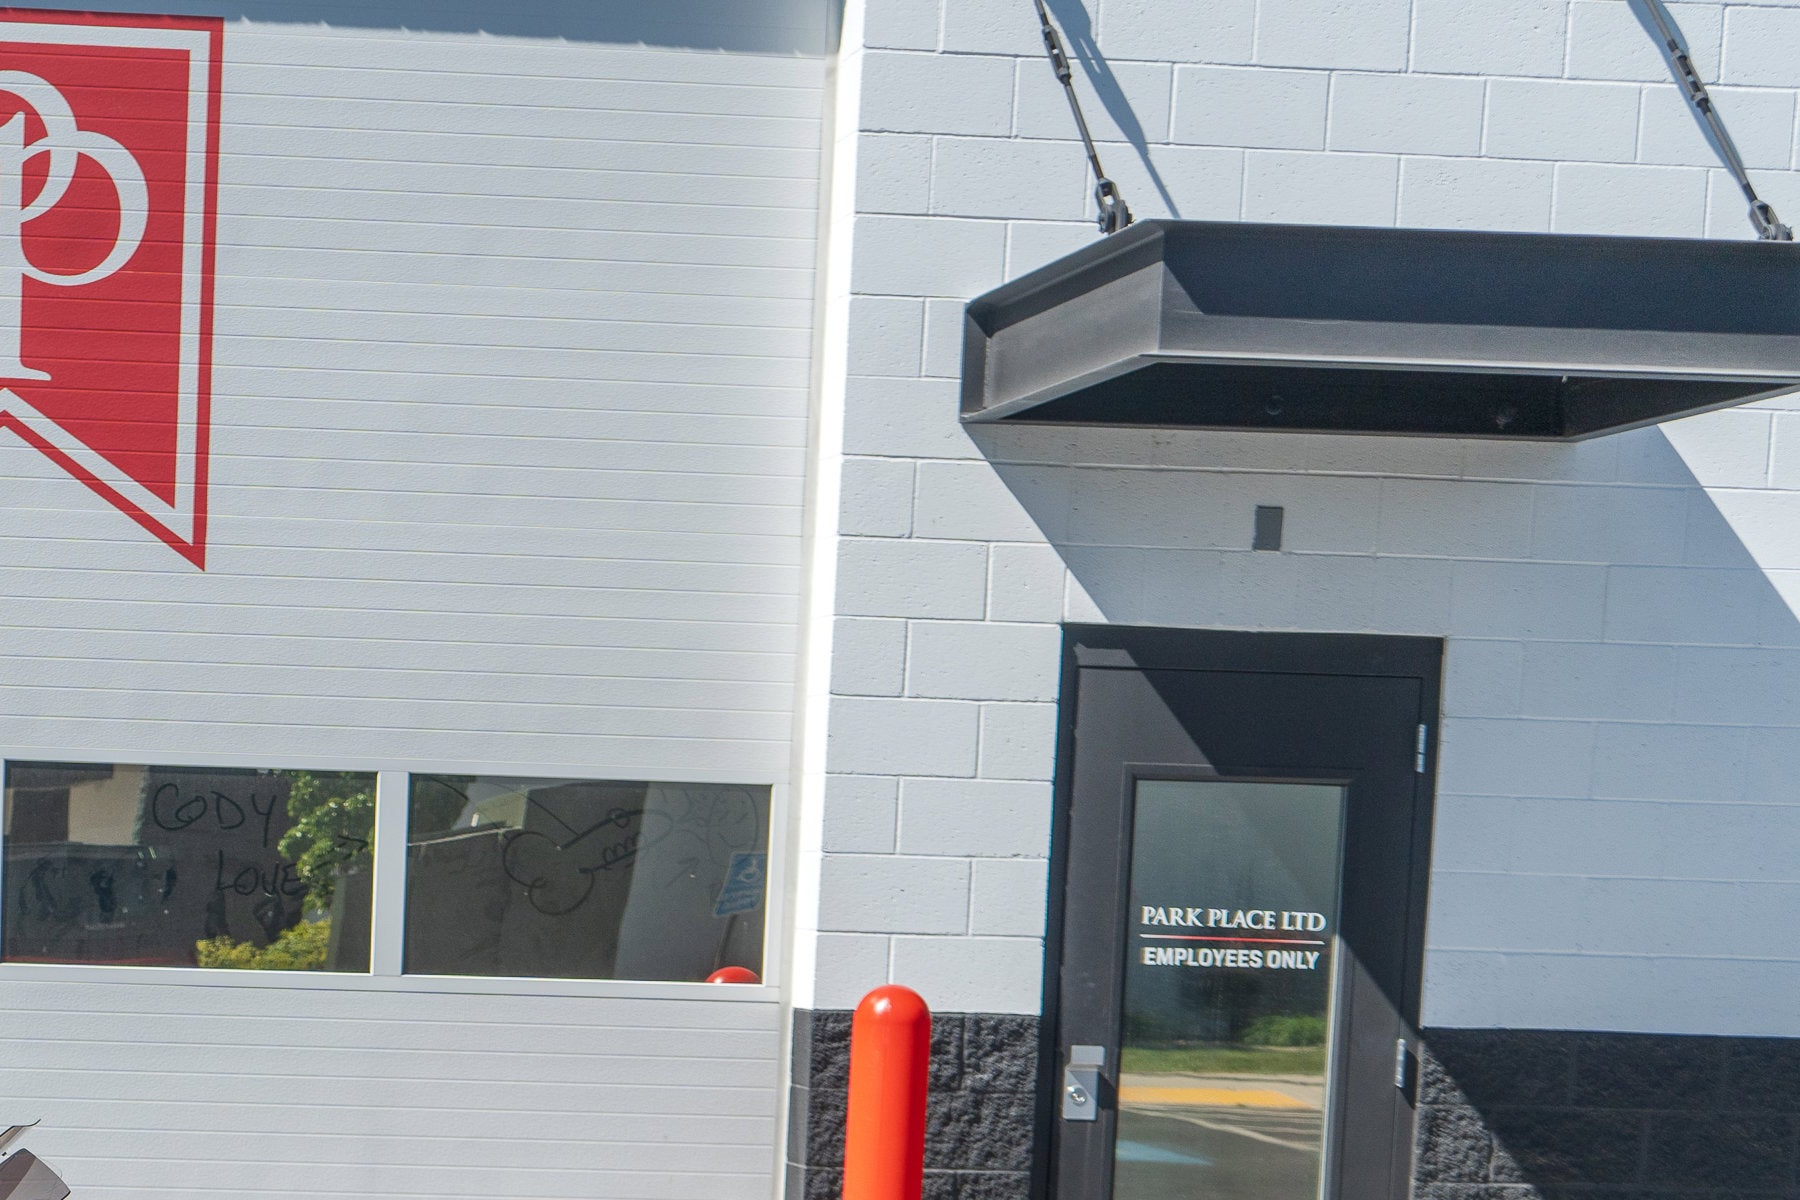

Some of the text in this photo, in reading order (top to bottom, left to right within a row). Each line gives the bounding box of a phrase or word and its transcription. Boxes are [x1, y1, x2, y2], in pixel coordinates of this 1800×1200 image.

[1140, 905, 1327, 932] PARK PLACE LTD
[1142, 947, 1321, 970] EMPLOYEES ONLY
